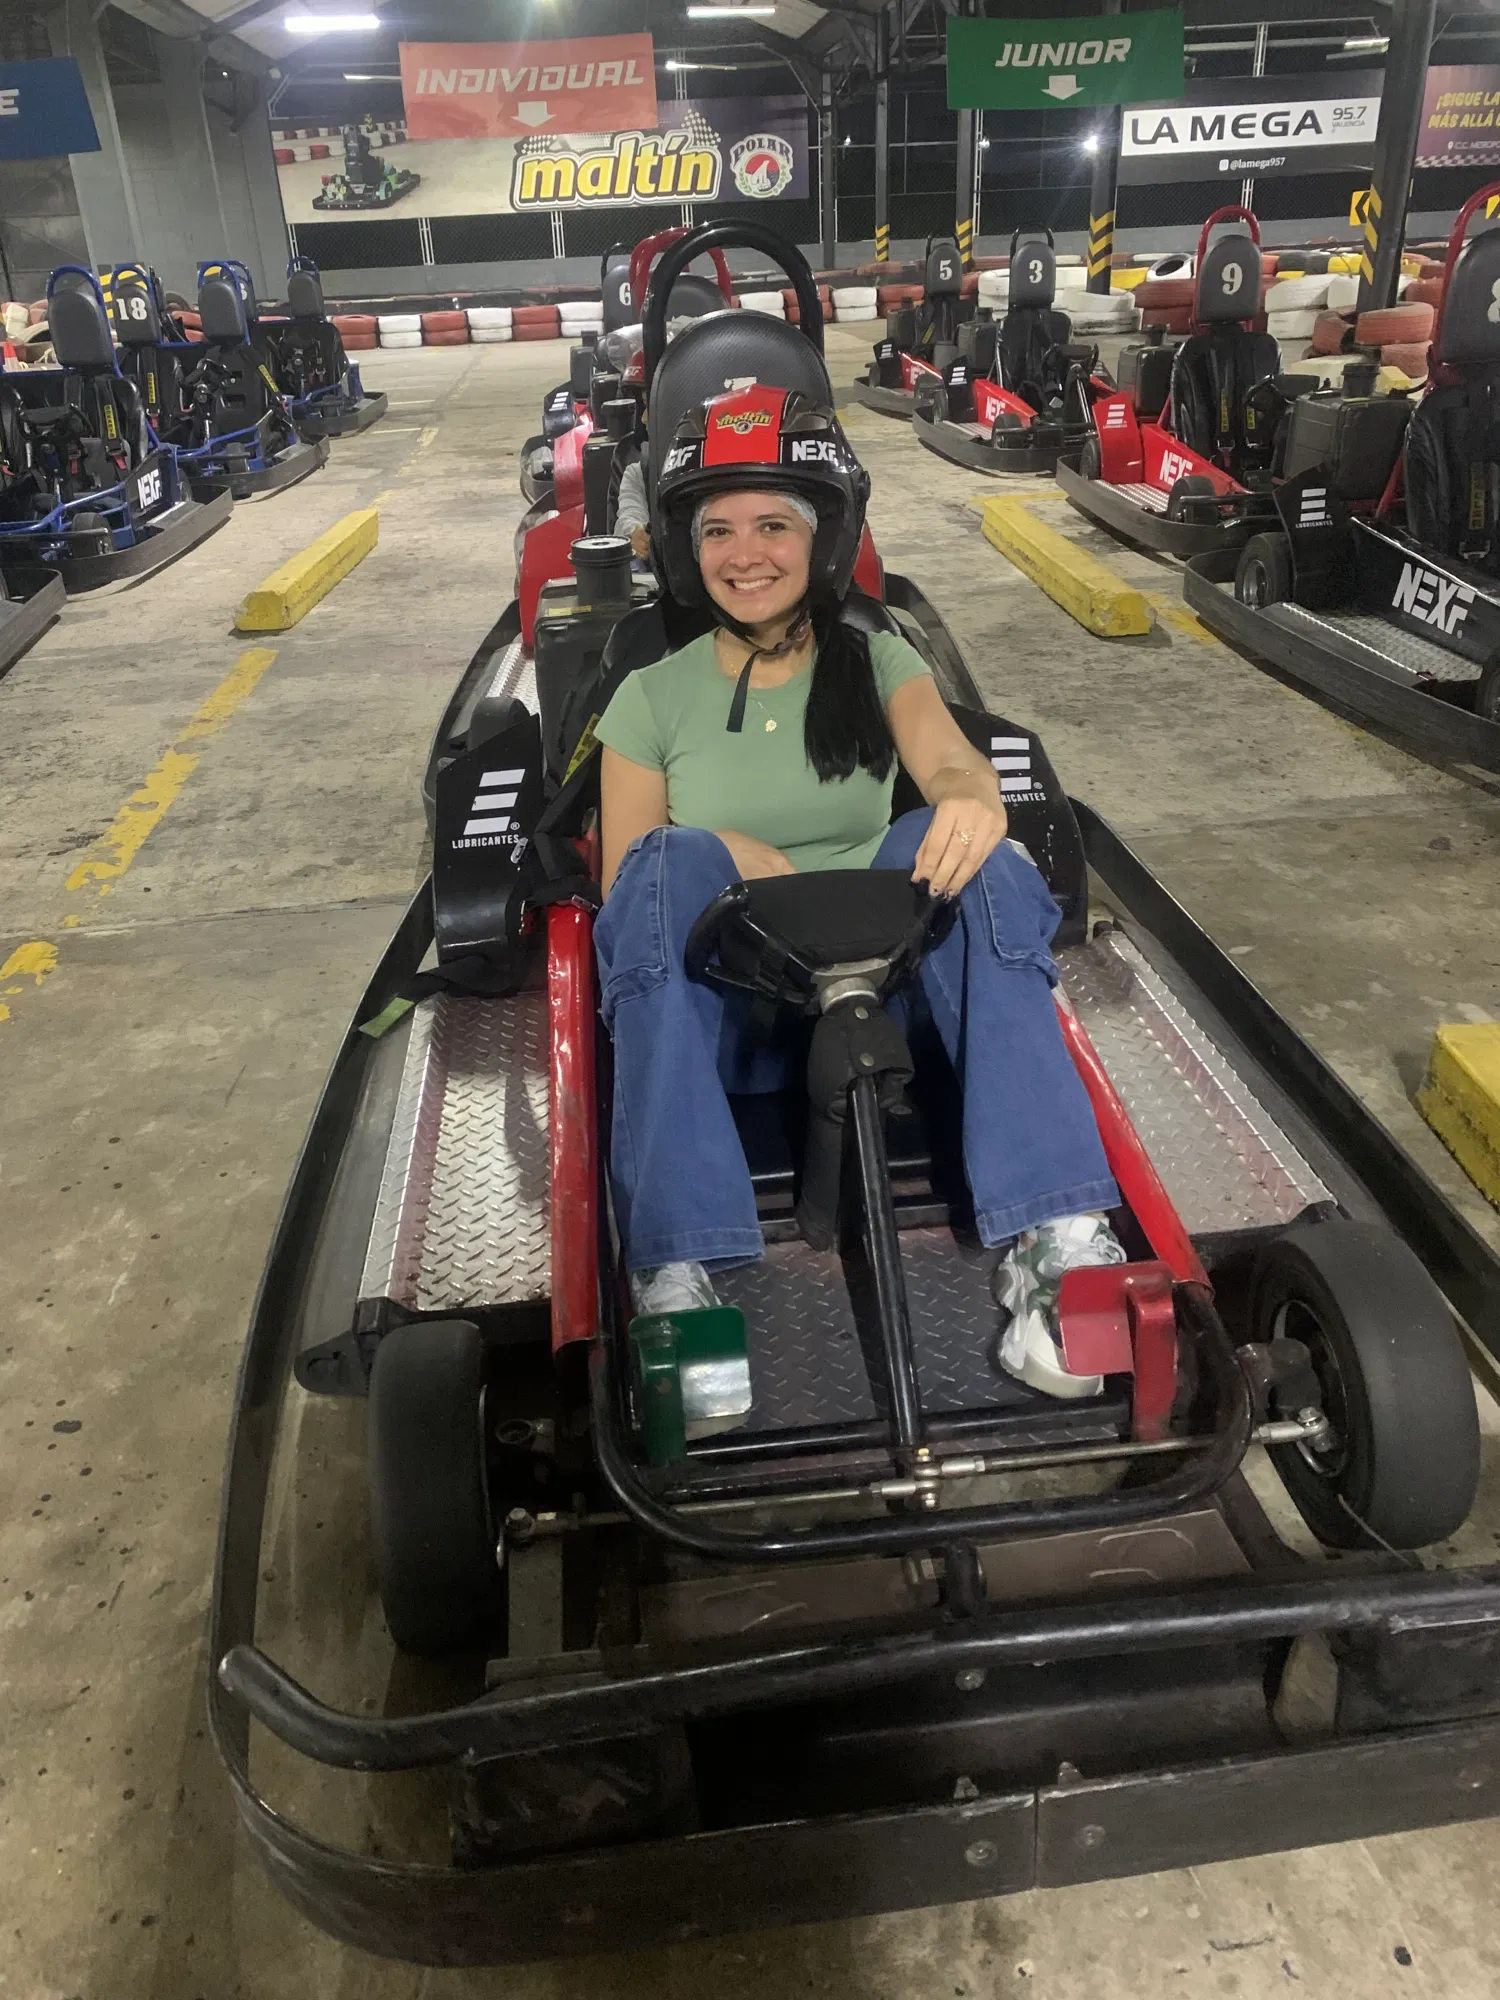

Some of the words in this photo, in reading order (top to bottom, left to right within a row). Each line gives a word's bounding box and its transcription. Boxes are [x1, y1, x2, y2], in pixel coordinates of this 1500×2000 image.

[995, 38, 1132, 67] JUNIOR
[416, 60, 644, 94] INDIVIDUAL
[1332, 106, 1367, 120] 95.7
[1428, 109, 1459, 129] MÁS
[1459, 108, 1494, 128] ALLÁ
[1131, 116, 1179, 145] LA
[1190, 109, 1323, 142] MEGA
[732, 137, 792, 169] POLAR
[1230, 157, 1286, 171] @lamega957
[519, 134, 717, 202] maltín
[939, 259, 953, 281] 5
[1028, 259, 1044, 283] 3
[1221, 262, 1244, 296] 9
[116, 297, 147, 321] 18
[1295, 520, 1334, 529] LUBRICANTES
[452, 834, 520, 849] LUBRICANTES
